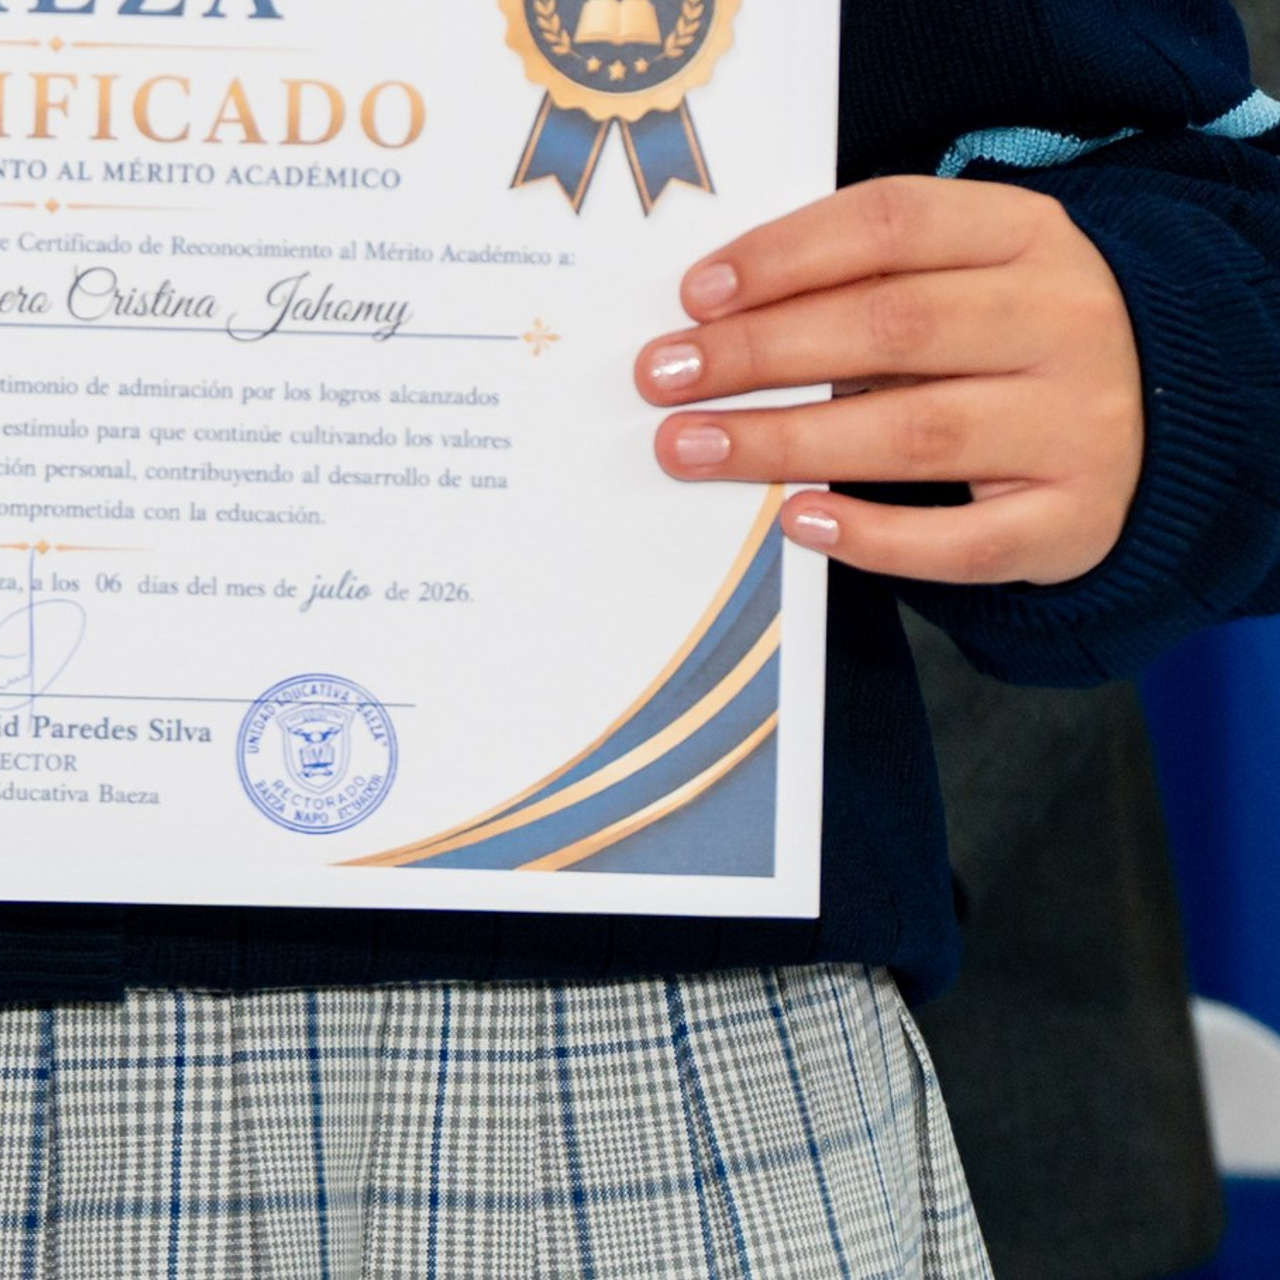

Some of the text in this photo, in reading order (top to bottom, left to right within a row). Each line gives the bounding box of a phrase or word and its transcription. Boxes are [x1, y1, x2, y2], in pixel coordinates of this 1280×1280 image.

[58, 161, 91, 181] AL
[103, 162, 215, 184] MÉRITO
[226, 166, 401, 189] ACADÉMICO
[17, 233, 133, 254] Certificado
[138, 235, 163, 255] de
[171, 235, 333, 259] Reconocimiento
[339, 241, 357, 260] al
[364, 241, 434, 262] Mérito
[440, 244, 552, 265] Académico
[558, 253, 571, 266] a:
[67, 265, 219, 322] Cristina
[226, 269, 413, 342] Jahomy
[85, 376, 110, 396] de
[117, 377, 233, 399] admiración
[241, 386, 275, 406] por
[283, 381, 312, 402] los
[319, 382, 382, 408] logros
[389, 384, 500, 406] alcanzados
[96, 425, 141, 444] para
[149, 427, 186, 446] que
[193, 427, 282, 444] continúe
[289, 425, 398, 447] cultivando
[405, 427, 433, 447] los
[441, 429, 512, 450] valores
[44, 459, 137, 484] personal,
[144, 461, 294, 487] contribuyendo
[302, 464, 320, 485] al
[328, 465, 431, 487] desarrollo
[437, 468, 462, 488] de
[470, 475, 509, 490] una
[143, 507, 181, 521] con
[189, 501, 207, 522] la
[215, 502, 325, 525] educación.
[31, 578, 44, 593] a
[51, 571, 80, 594] los
[95, 573, 123, 593] 06
[186, 575, 218, 596] del
[225, 583, 267, 598] mes
[272, 578, 298, 599] de
[300, 569, 373, 612] julio
[384, 581, 410, 602] de
[417, 581, 474, 603] 2026.
[29, 714, 139, 742] Paredes
[148, 717, 213, 743] Silva
[248, 703, 276, 754] UNIDAD
[275, 684, 350, 707] EDUCATIVA
[98, 783, 160, 805] Baeza
[254, 773, 384, 824] BAEZA NAPO ECUADOR
[271, 775, 367, 811] RECTORADO
